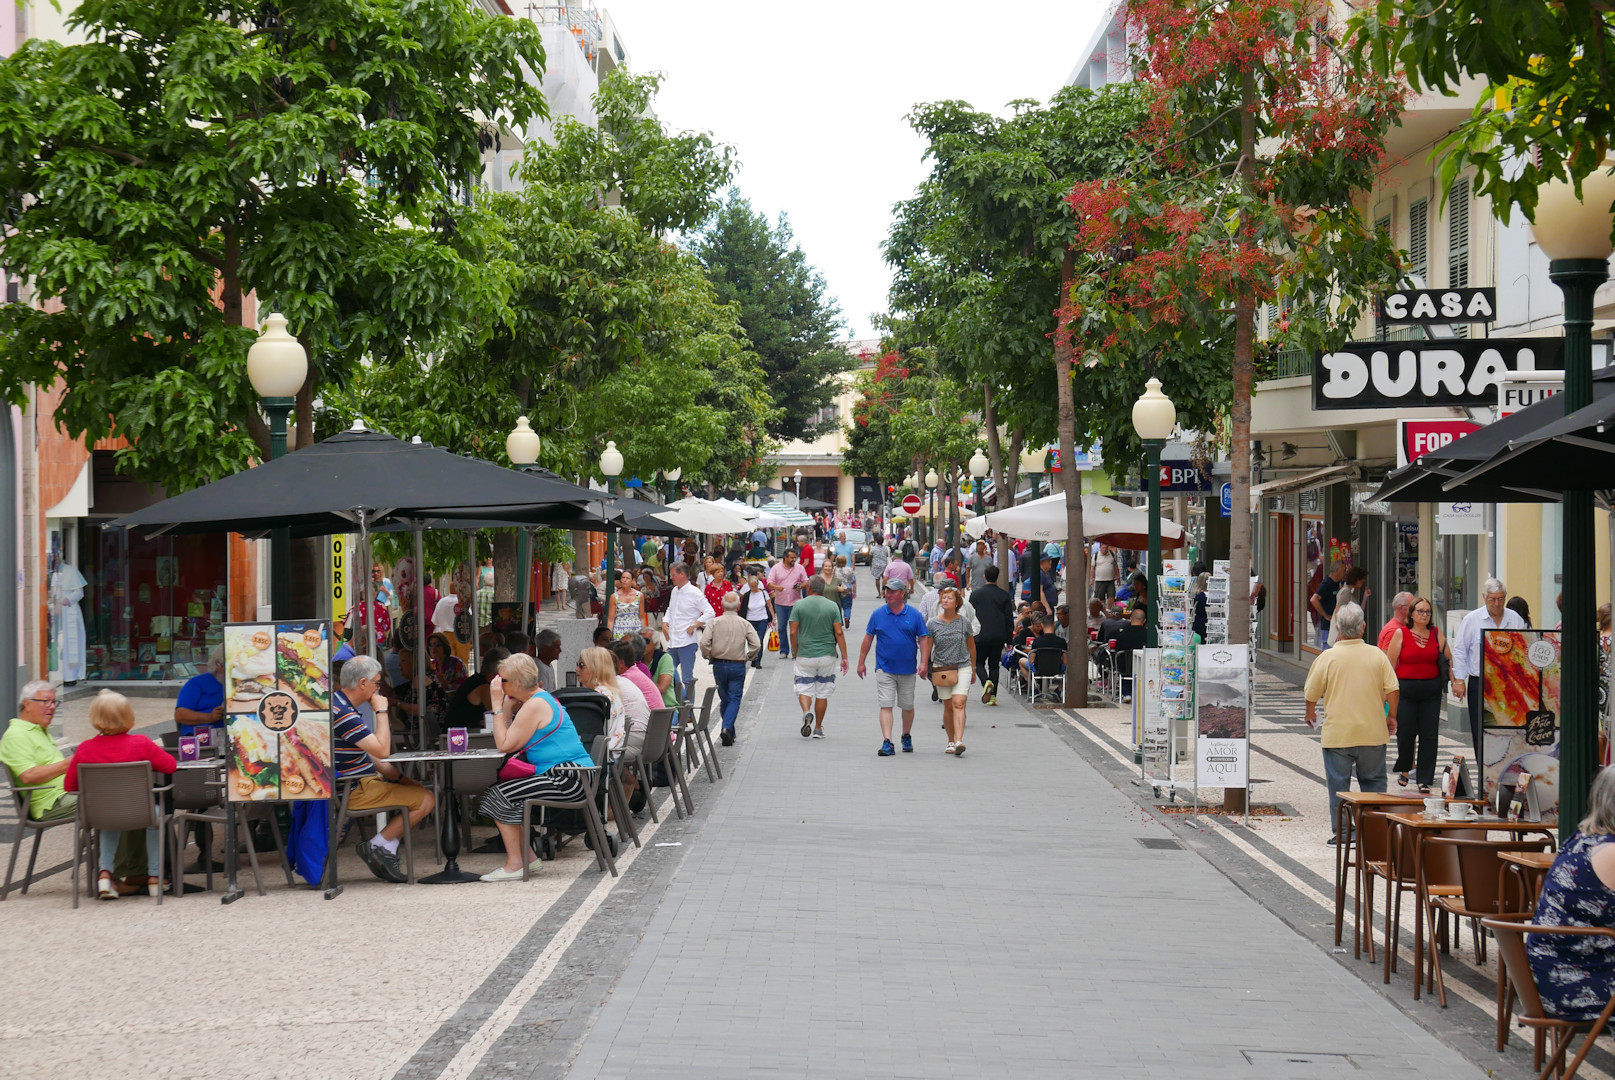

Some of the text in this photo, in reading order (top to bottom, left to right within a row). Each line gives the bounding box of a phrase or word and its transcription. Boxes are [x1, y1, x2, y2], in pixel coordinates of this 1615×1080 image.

[1385, 292, 1492, 319] CASA
[1172, 468, 1199, 484] BPI
[333, 540, 343, 599] OURO
[1533, 646, 1551, 656] 100
[1206, 747, 1238, 756] AMOR
[1206, 763, 1237, 774] AQUI
